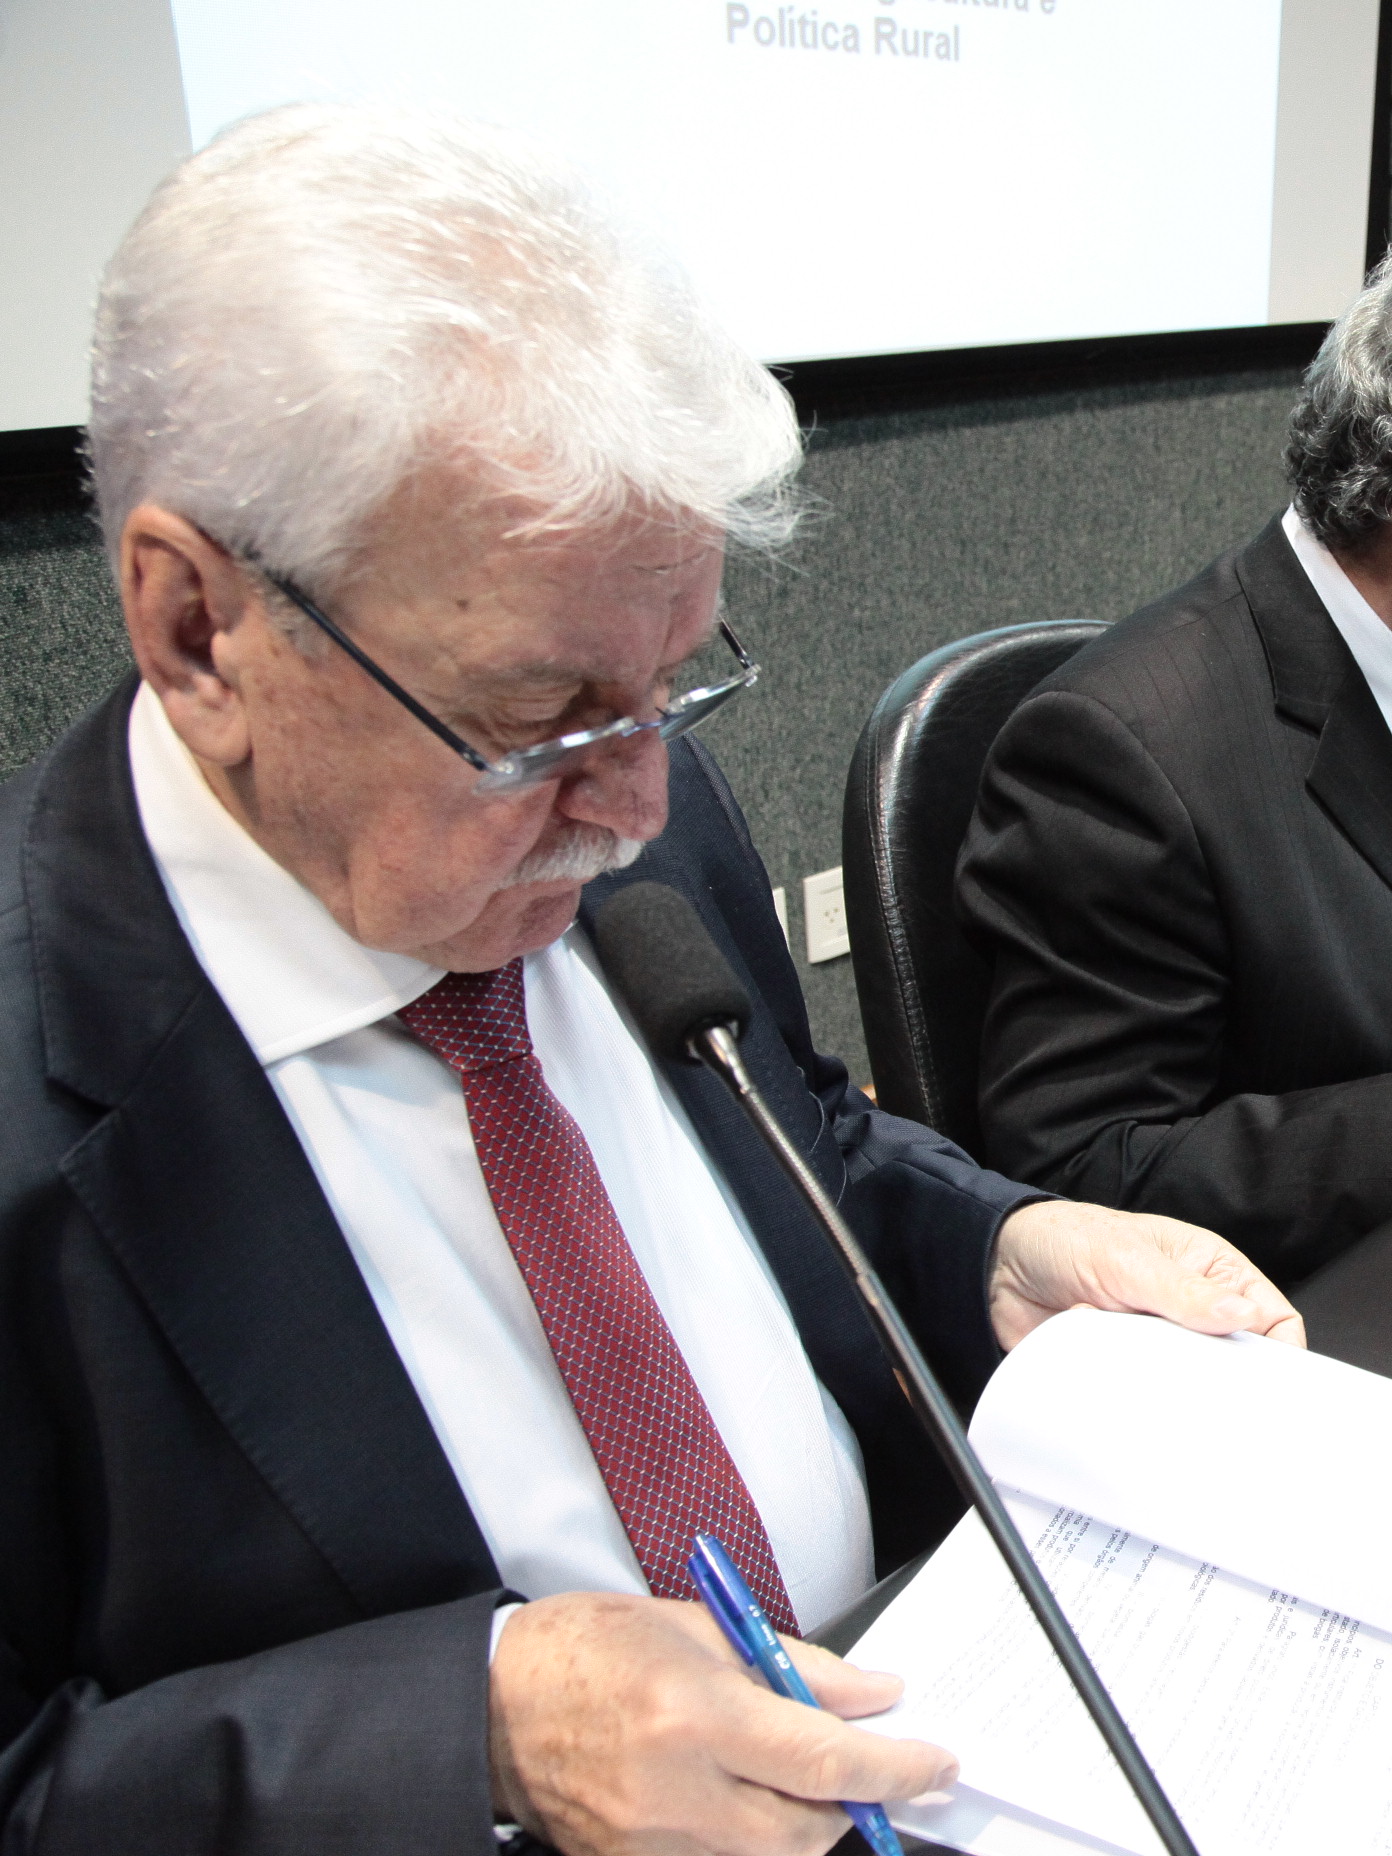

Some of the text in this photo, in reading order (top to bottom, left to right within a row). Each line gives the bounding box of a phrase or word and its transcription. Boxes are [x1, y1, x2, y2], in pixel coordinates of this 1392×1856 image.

[725, 1, 961, 63] Política Rural
[1077, 1522, 1090, 1536] entre
[1063, 1531, 1073, 1541] que
[1067, 1543, 1076, 1554] por
[1151, 1544, 1160, 1552] de
[1204, 1573, 1214, 1585] dos
[1279, 1593, 1289, 1604] por
[1321, 1609, 1331, 1617] de
[1374, 1659, 1384, 1669] DO
